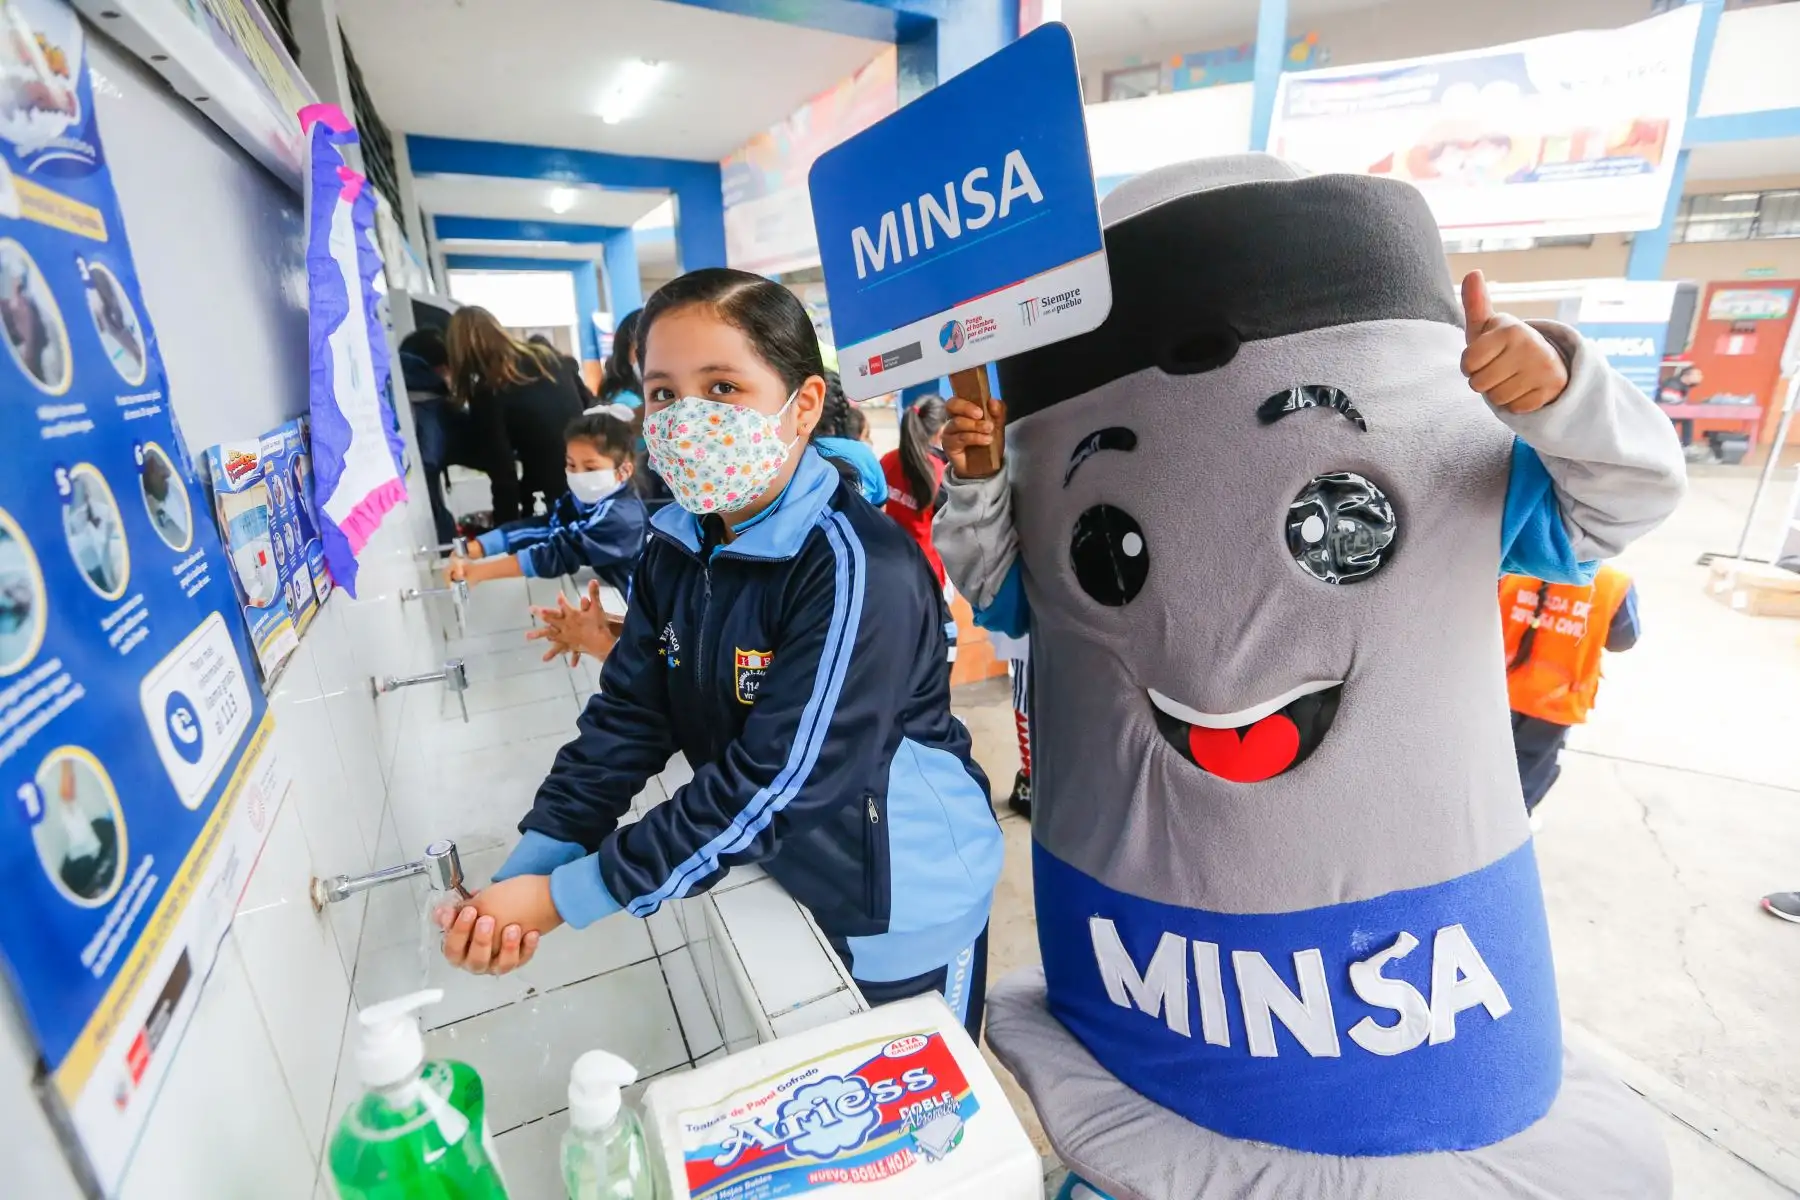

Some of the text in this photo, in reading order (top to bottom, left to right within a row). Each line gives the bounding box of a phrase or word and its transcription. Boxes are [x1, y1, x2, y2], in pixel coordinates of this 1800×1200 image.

[851, 149, 1044, 280] MINSA
[1041, 288, 1081, 308] Siempre
[1056, 298, 1082, 314] pueblo
[55, 467, 71, 496] 5
[1089, 916, 1512, 1056] MINSA
[891, 1036, 919, 1050] ALTA
[730, 1106, 745, 1118] de
[746, 1090, 777, 1111] Papel
[777, 1067, 819, 1092] Gofrado
[898, 1090, 953, 1120] DOBLE
[809, 1148, 916, 1184] NUEVO DOBLE HOJA
